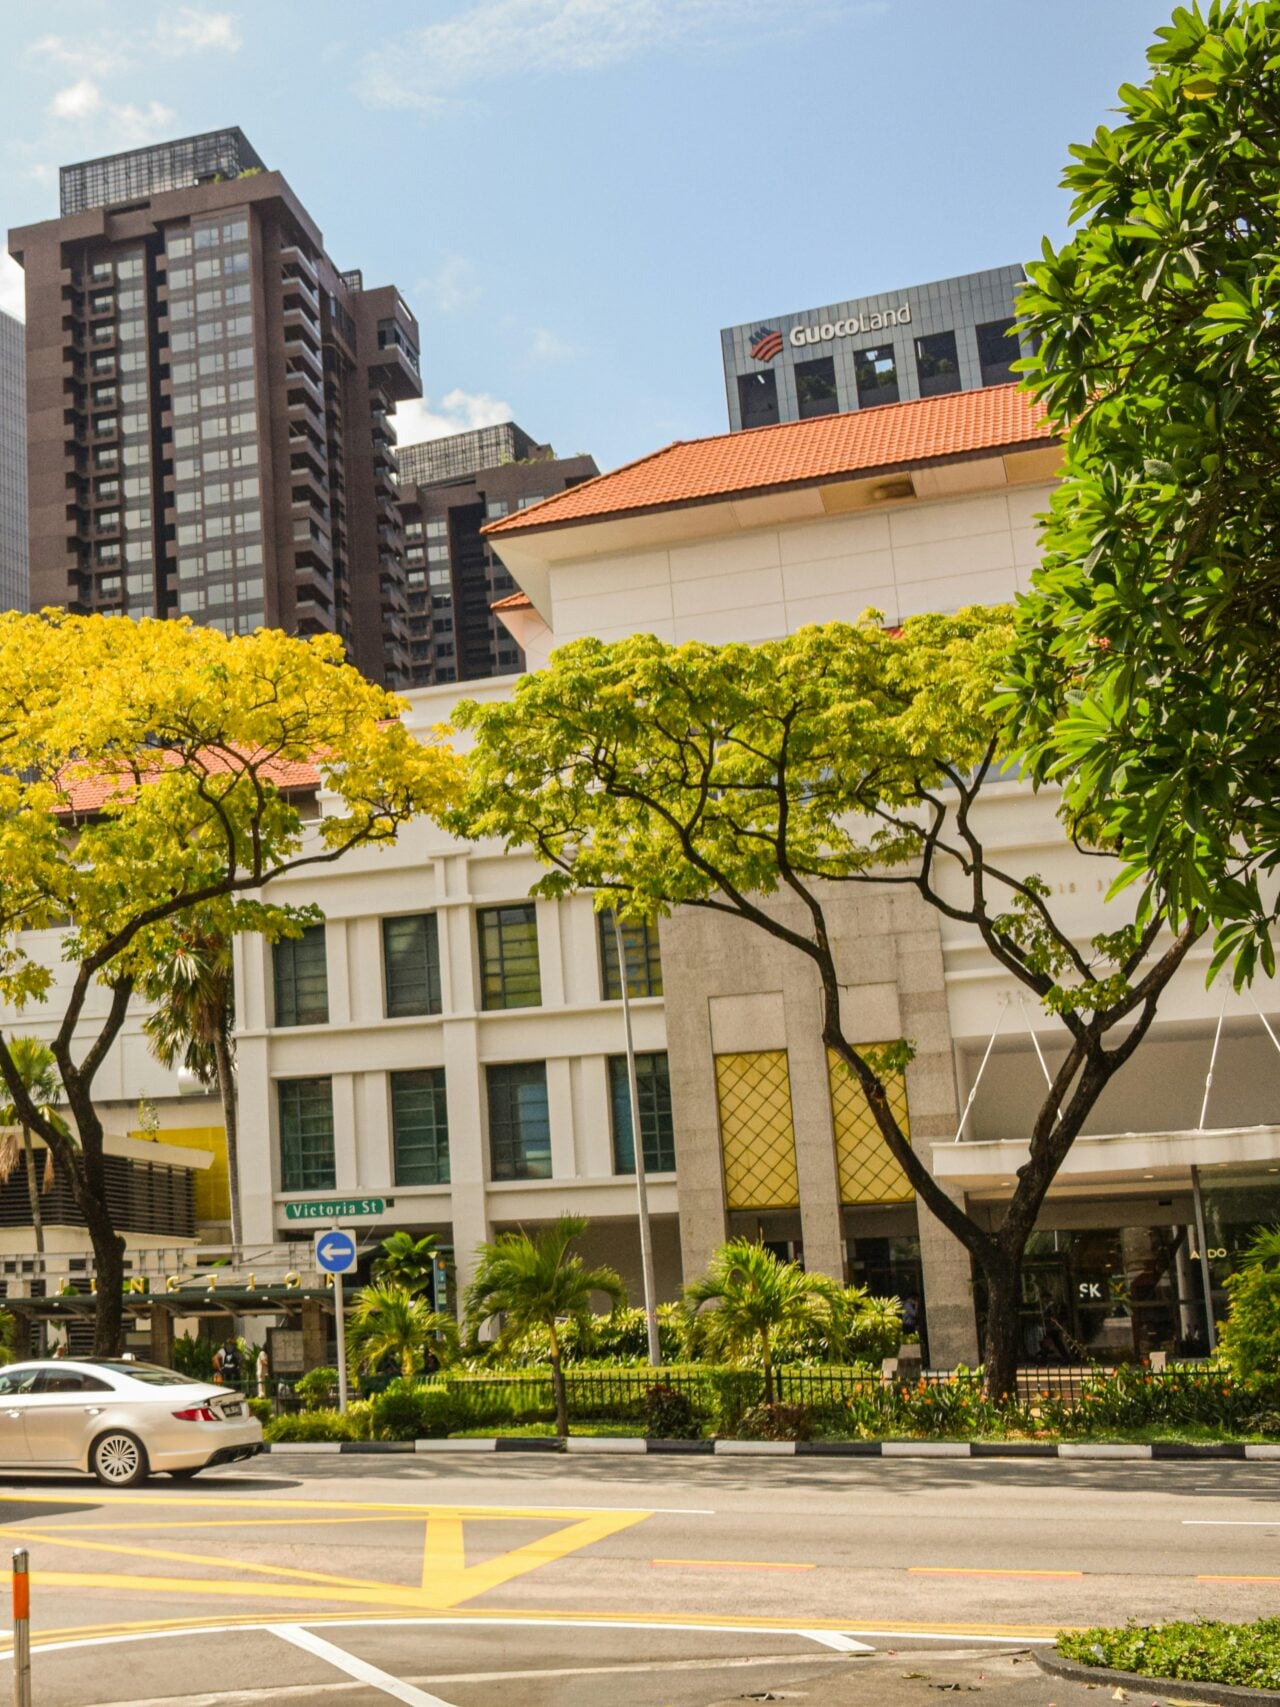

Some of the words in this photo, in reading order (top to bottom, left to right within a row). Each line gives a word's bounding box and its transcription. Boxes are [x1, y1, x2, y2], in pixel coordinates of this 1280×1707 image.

[789, 303, 912, 347] GuocoLand
[292, 1203, 356, 1217] Victoria
[362, 1200, 377, 1213] St
[1189, 1247, 1228, 1260] ADO
